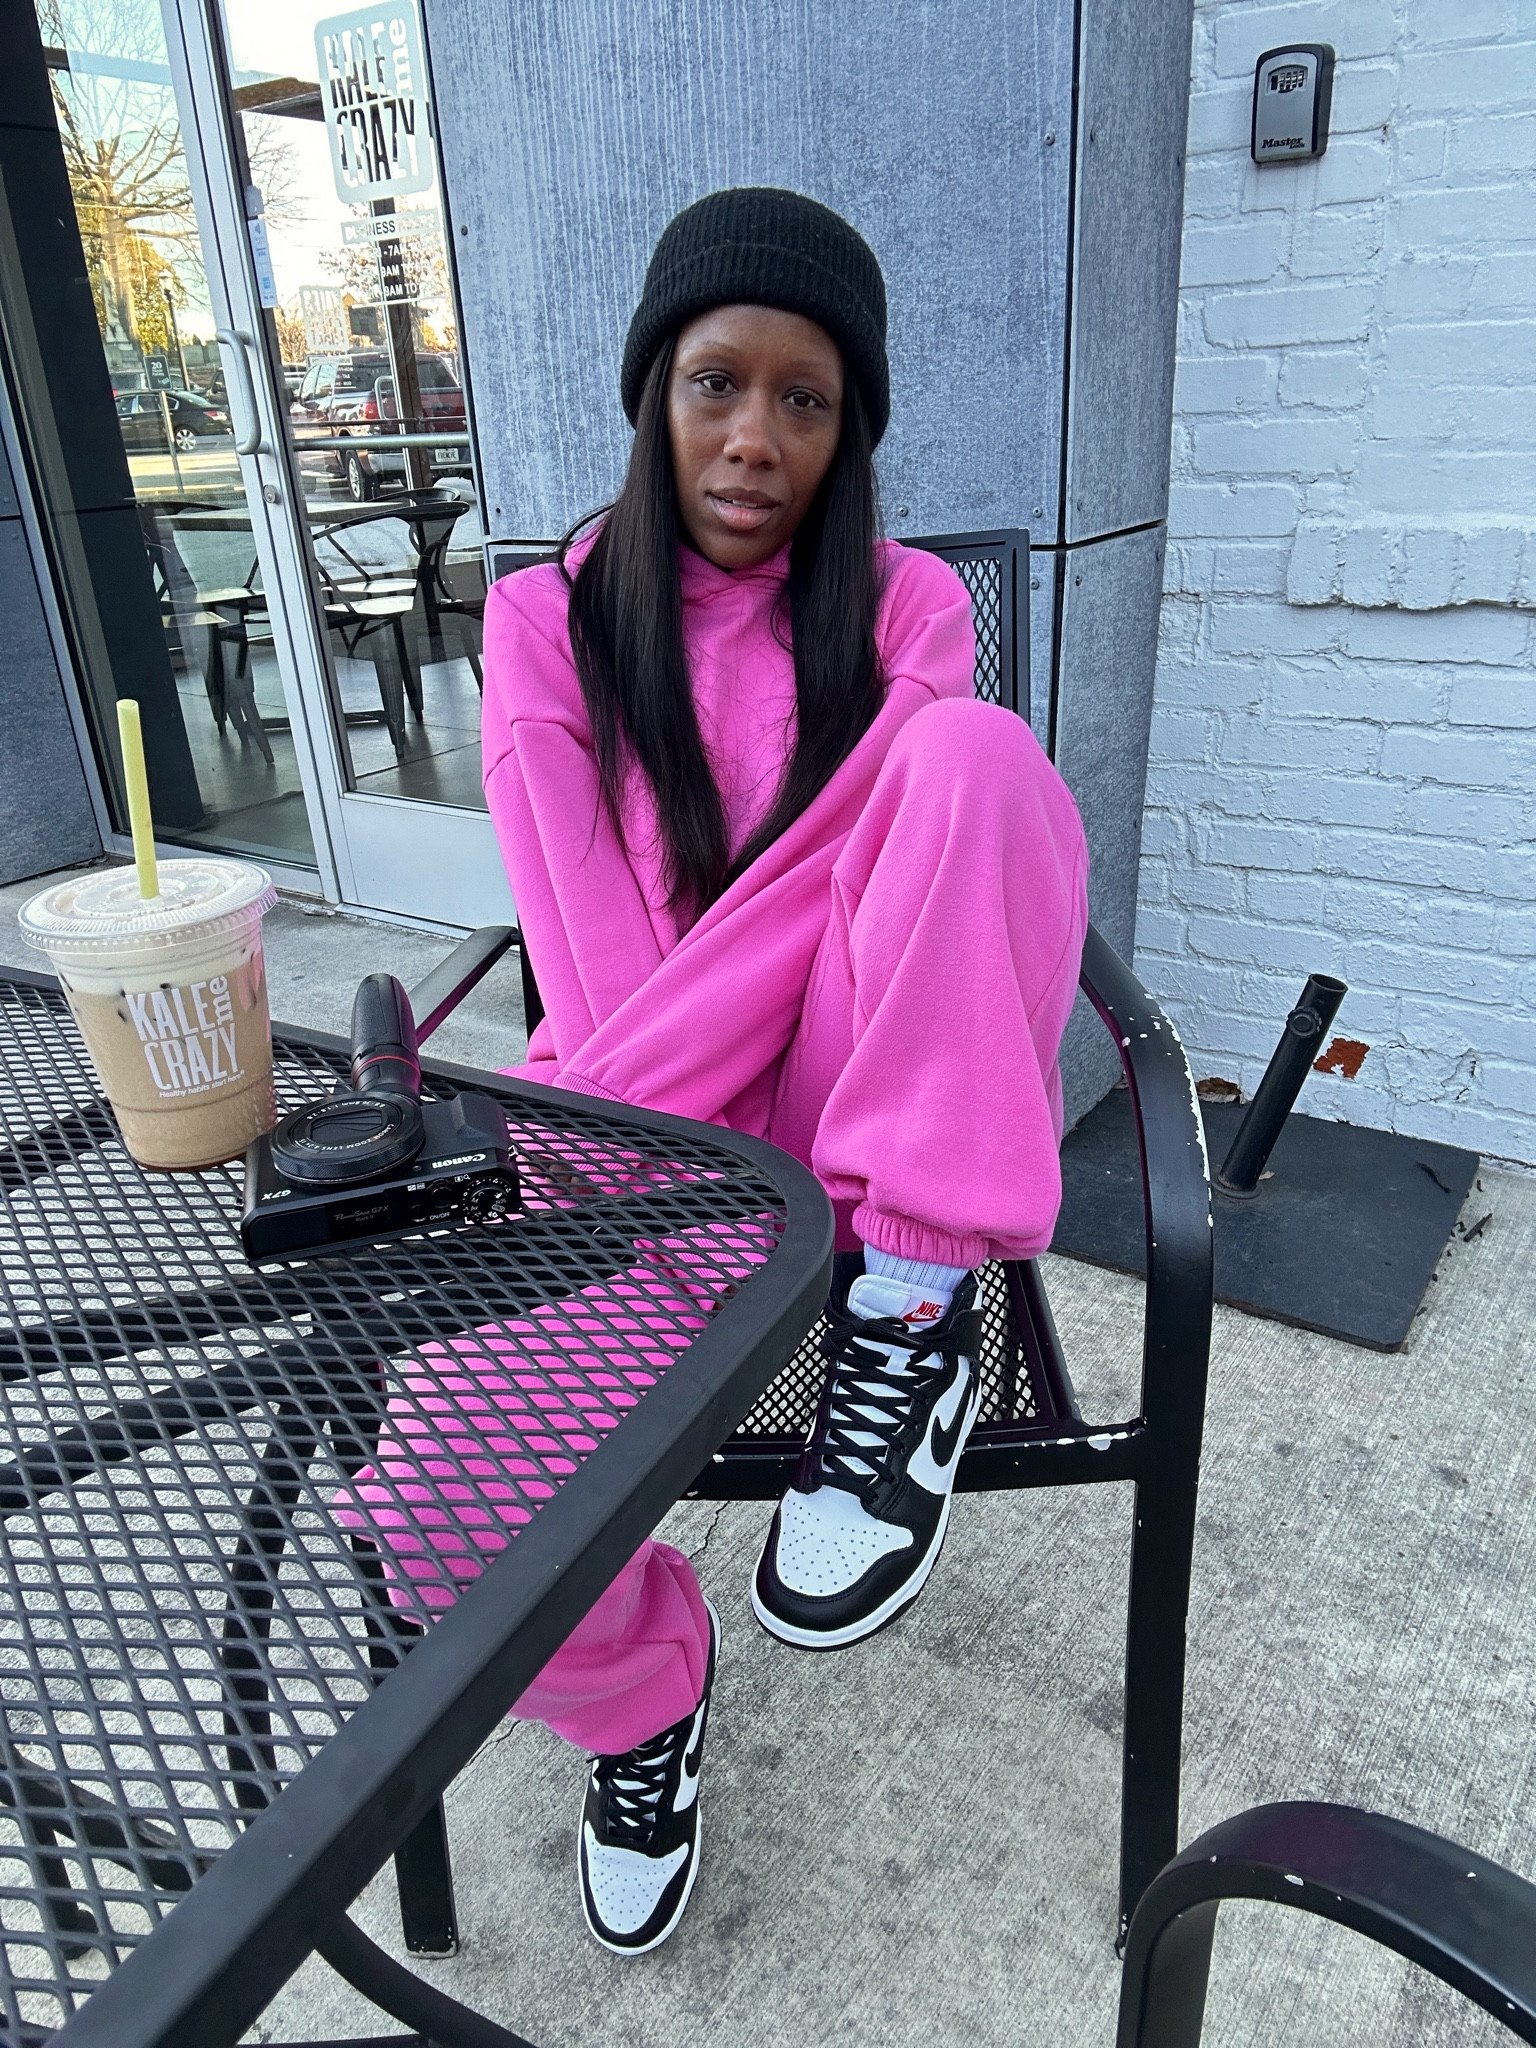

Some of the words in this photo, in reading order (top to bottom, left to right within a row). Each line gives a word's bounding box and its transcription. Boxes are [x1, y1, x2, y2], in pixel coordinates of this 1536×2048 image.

[323, 21, 393, 108] KALE
[389, 17, 414, 96] me
[336, 98, 419, 187] CRAZY
[1261, 137, 1303, 149] Master
[151, 361, 162, 370] 20
[209, 975, 234, 1026] me
[125, 981, 216, 1042] KALE
[144, 1022, 239, 1091] CRAZY
[159, 1088, 187, 1099] Healthy
[187, 1084, 210, 1095] habits
[211, 1078, 228, 1089] start
[372, 1123, 395, 1140] CANON
[346, 1138, 371, 1149] ZOOM
[432, 1153, 487, 1169] Canon
[429, 1211, 451, 1221] ON/OFF
[915, 1300, 942, 1318] NIKE
